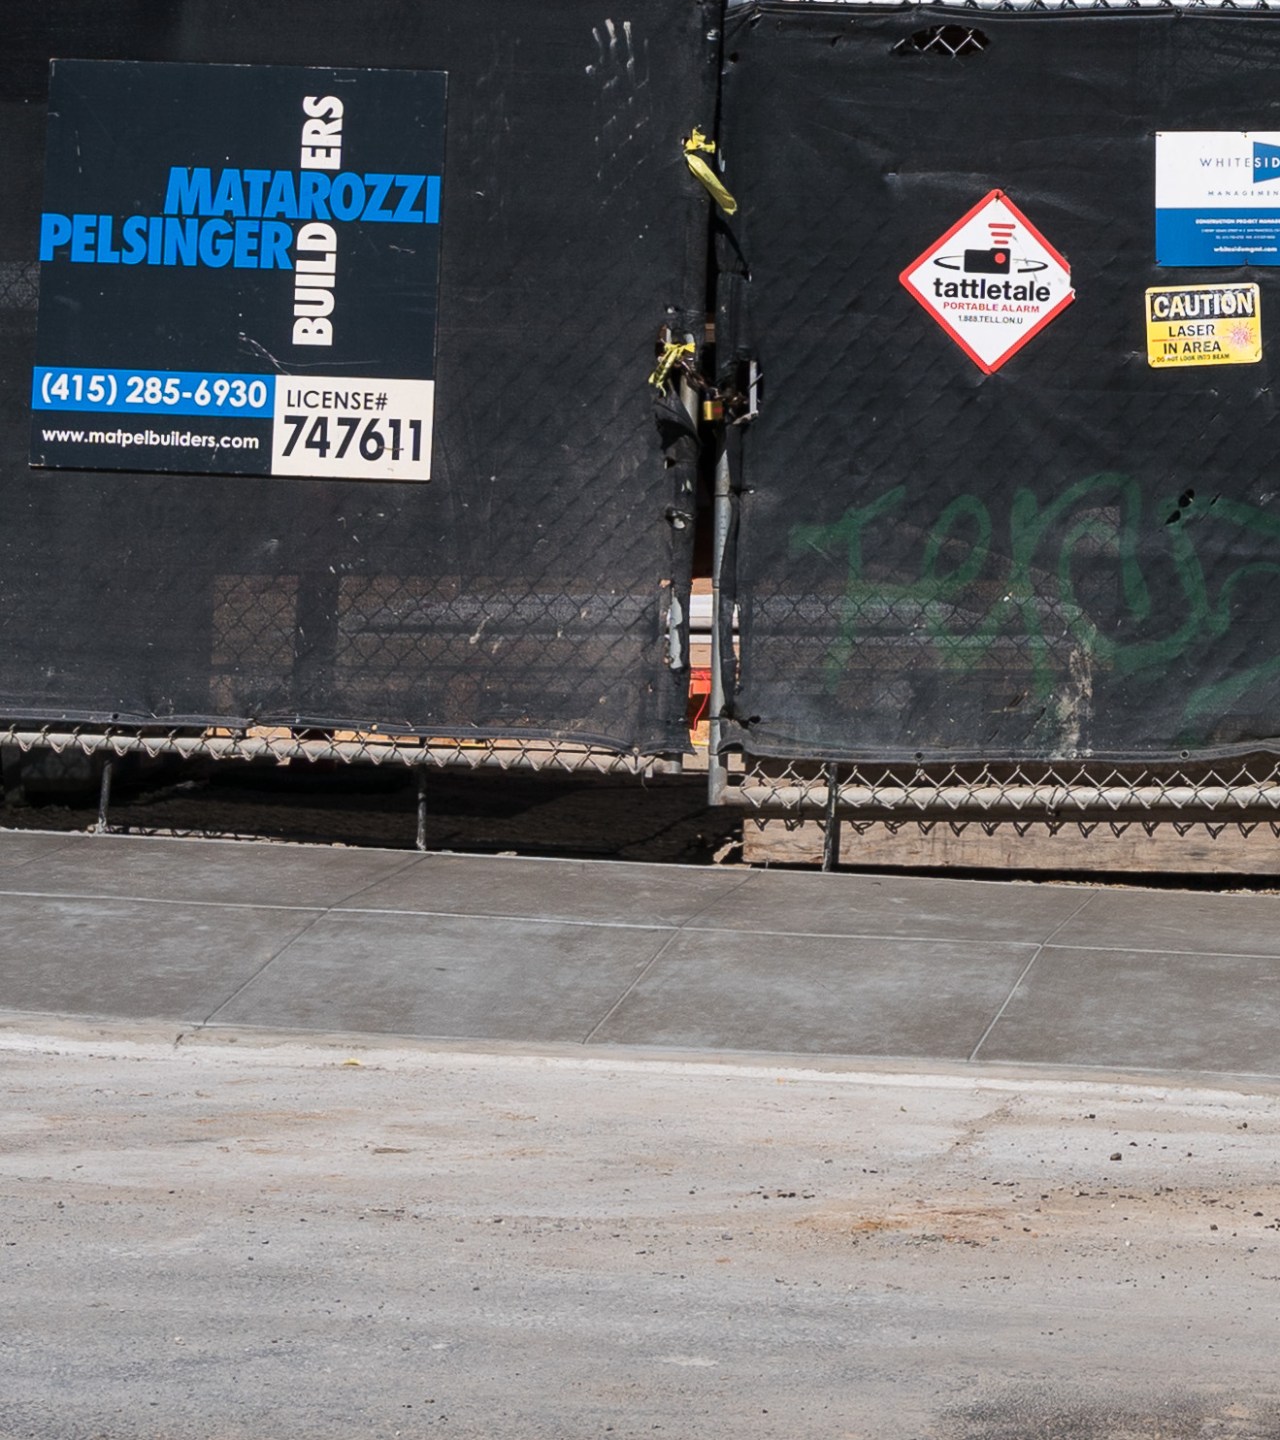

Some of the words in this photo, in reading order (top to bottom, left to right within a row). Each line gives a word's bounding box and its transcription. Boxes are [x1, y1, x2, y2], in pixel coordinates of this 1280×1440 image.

[163, 166, 442, 224] MATAROZZI
[39, 213, 294, 270] PELSINGER
[932, 277, 1051, 302] tattletale
[943, 302, 998, 311] PORTABLE
[1001, 304, 1040, 313] ALARM
[1153, 292, 1254, 318] CAUTION
[1168, 324, 1215, 338] LASER
[1163, 342, 1177, 354] IN
[1182, 341, 1222, 354] AREA
[41, 372, 118, 406] (415)
[125, 376, 267, 408] 285-6930
[287, 389, 388, 411] LICENSE#
[42, 427, 259, 450] www.matpelbuilders.com
[281, 415, 423, 462] 747611
